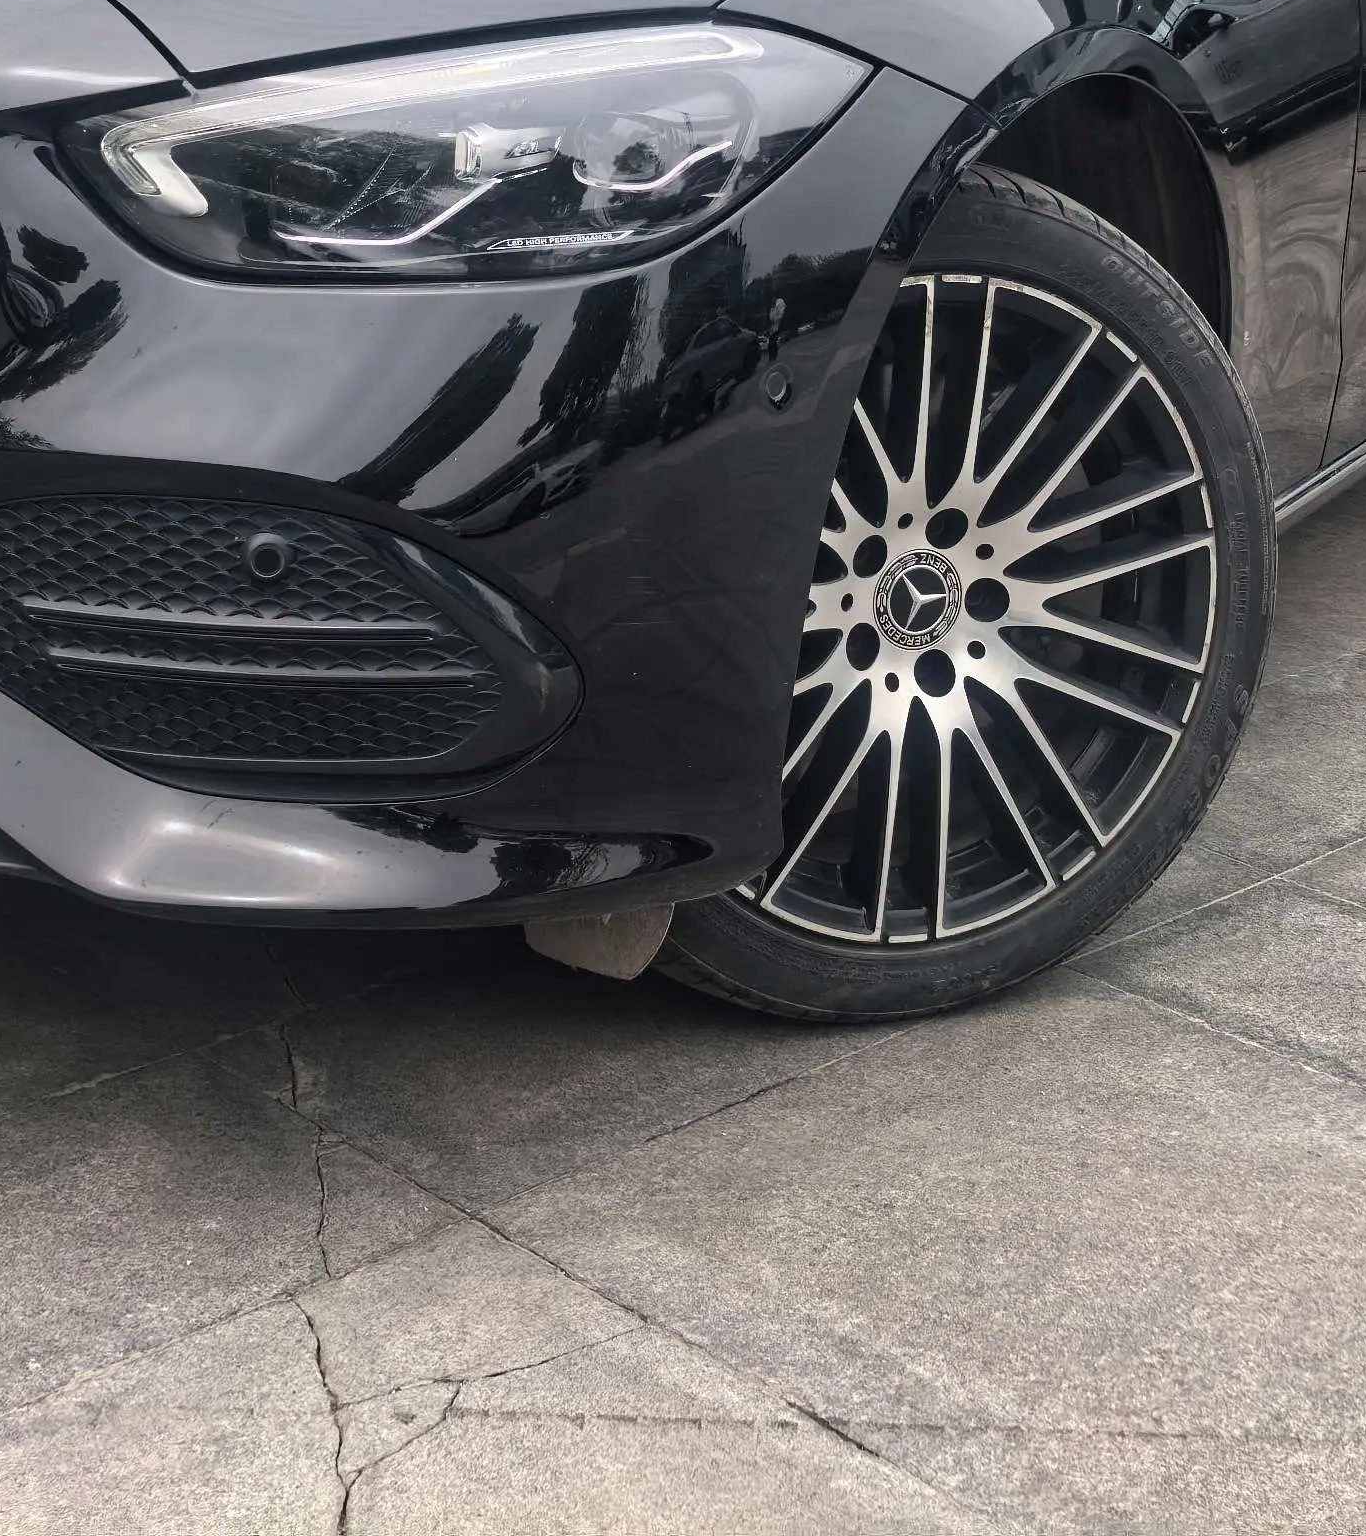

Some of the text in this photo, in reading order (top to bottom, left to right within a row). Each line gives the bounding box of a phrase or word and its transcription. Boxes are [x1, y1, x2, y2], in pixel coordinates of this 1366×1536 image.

[526, 237, 547, 246] HIGH
[550, 233, 615, 245] PERFORMANCE
[920, 553, 948, 573] BENZ
[879, 614, 931, 646] MERCEDES
